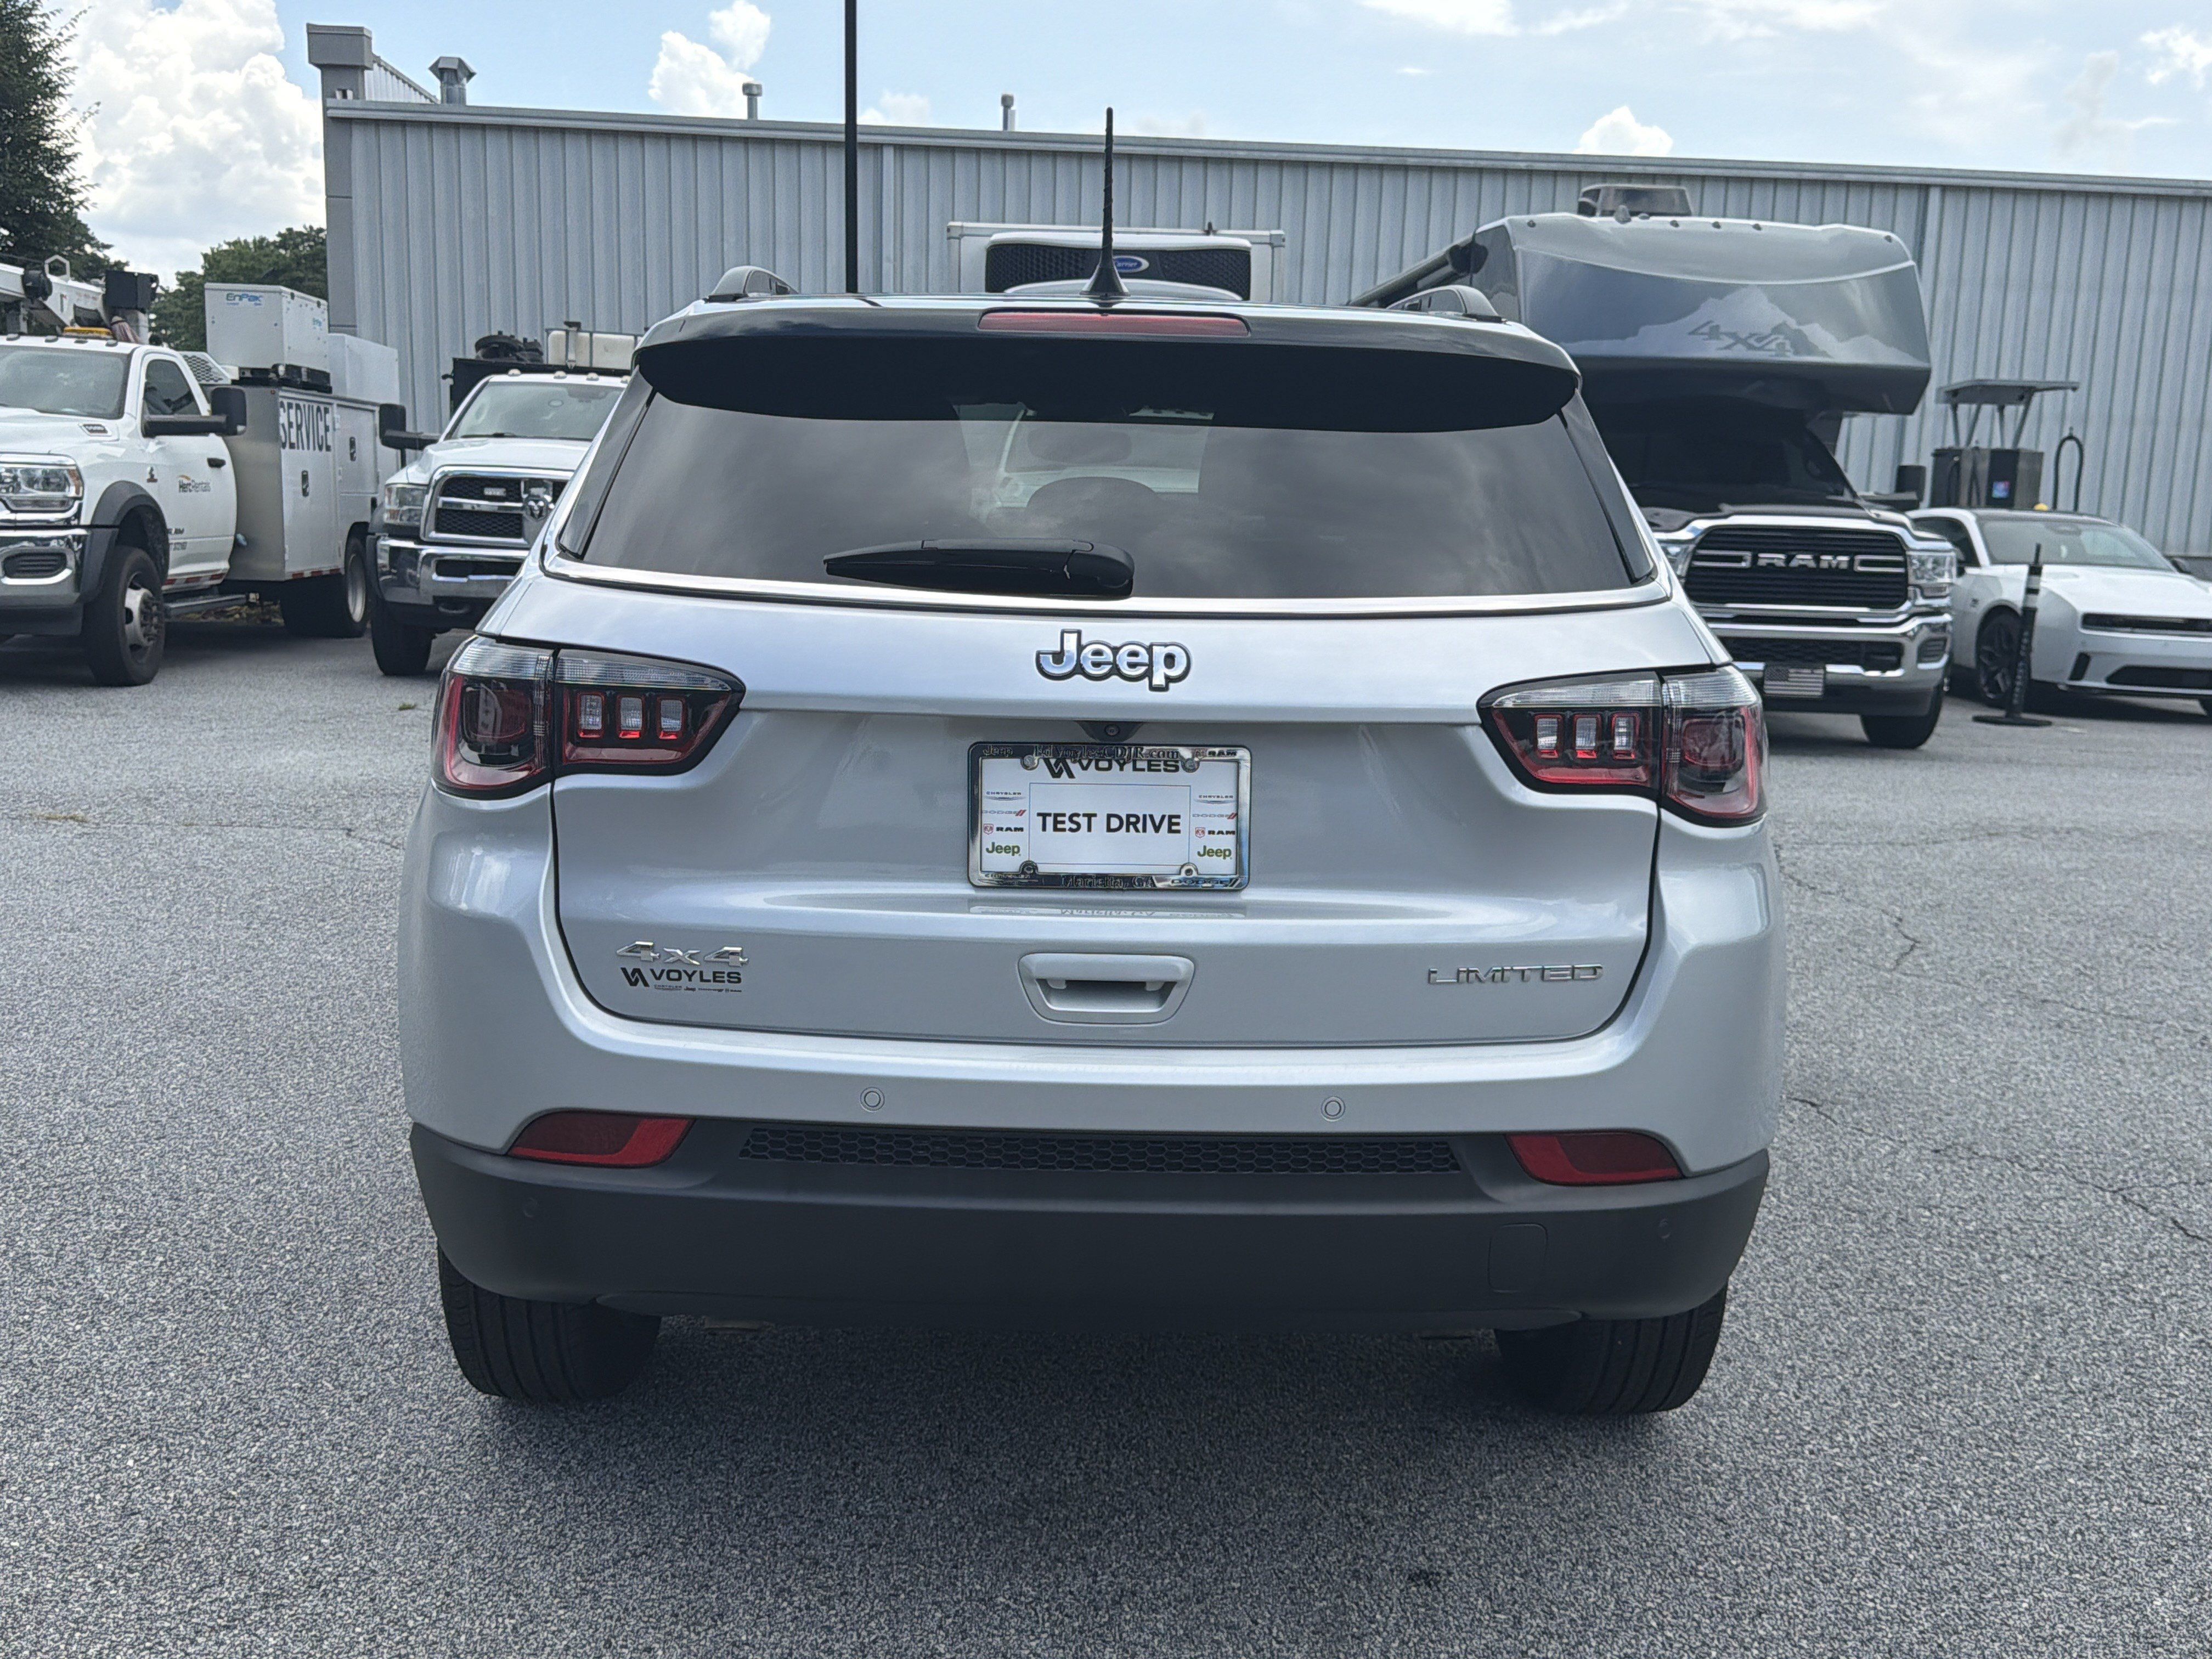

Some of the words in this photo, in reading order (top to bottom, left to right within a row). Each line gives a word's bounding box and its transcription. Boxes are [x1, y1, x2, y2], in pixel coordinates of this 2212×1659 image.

[280, 400, 331, 452] SERVICE
[1757, 552, 1850, 569] RAM
[1036, 629, 1192, 692] Jeep
[1078, 758, 1180, 773] VOYLES
[1036, 812, 1097, 832] TEST
[1106, 813, 1181, 834] DRIVE
[985, 842, 1020, 856] Jeep
[1197, 845, 1232, 860] Jeep
[650, 968, 742, 984] VOYLES
[1427, 963, 1603, 984] LIMITED
